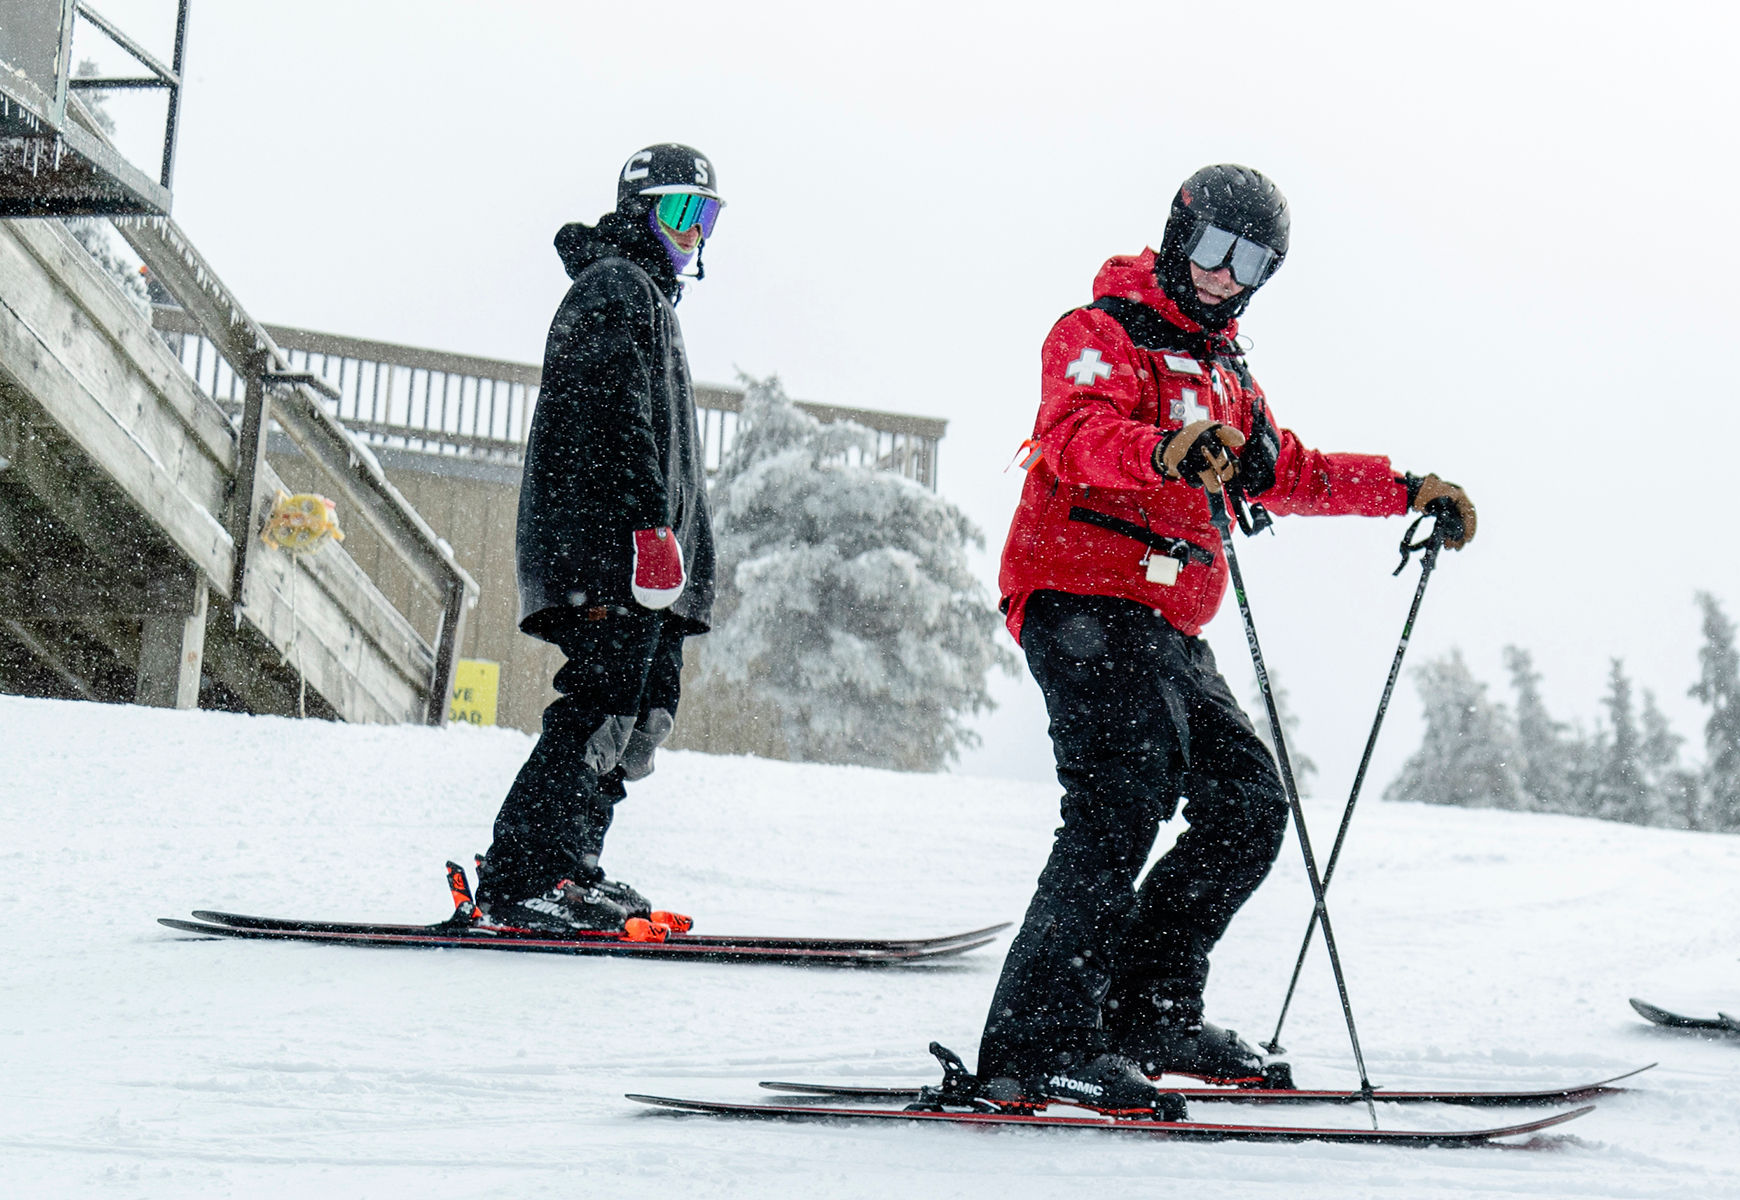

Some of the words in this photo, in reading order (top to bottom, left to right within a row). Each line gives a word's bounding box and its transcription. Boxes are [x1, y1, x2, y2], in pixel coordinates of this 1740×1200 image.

[624, 150, 653, 181] C
[694, 157, 709, 185] S
[1049, 1075, 1104, 1097] ATOMIC
